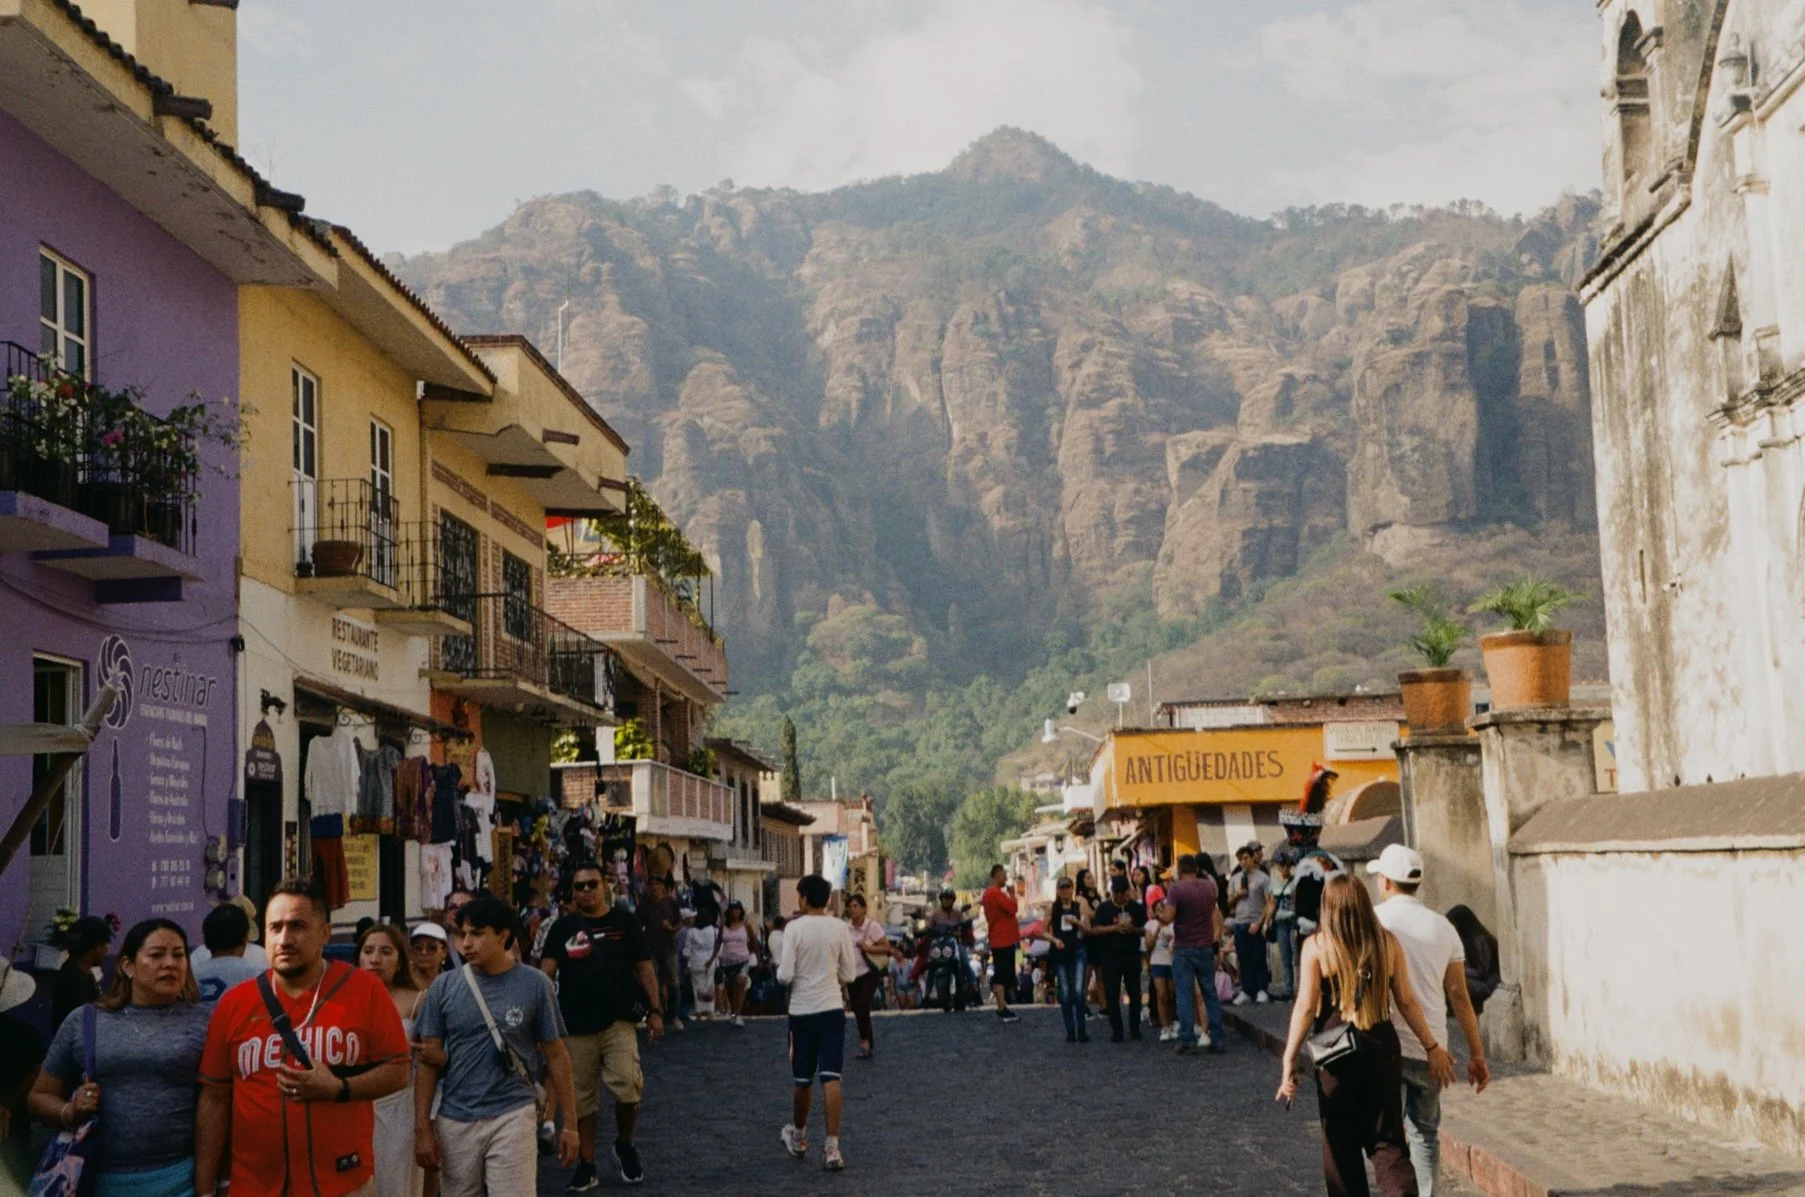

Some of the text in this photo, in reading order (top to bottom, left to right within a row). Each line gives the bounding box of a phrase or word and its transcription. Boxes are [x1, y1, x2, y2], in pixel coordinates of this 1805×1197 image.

[332, 616, 378, 654] RESTAURANTE
[332, 647, 379, 681] VEGETARIANO
[139, 663, 217, 707] nestinar
[1125, 750, 1284, 785] ANTIGÜEDADES
